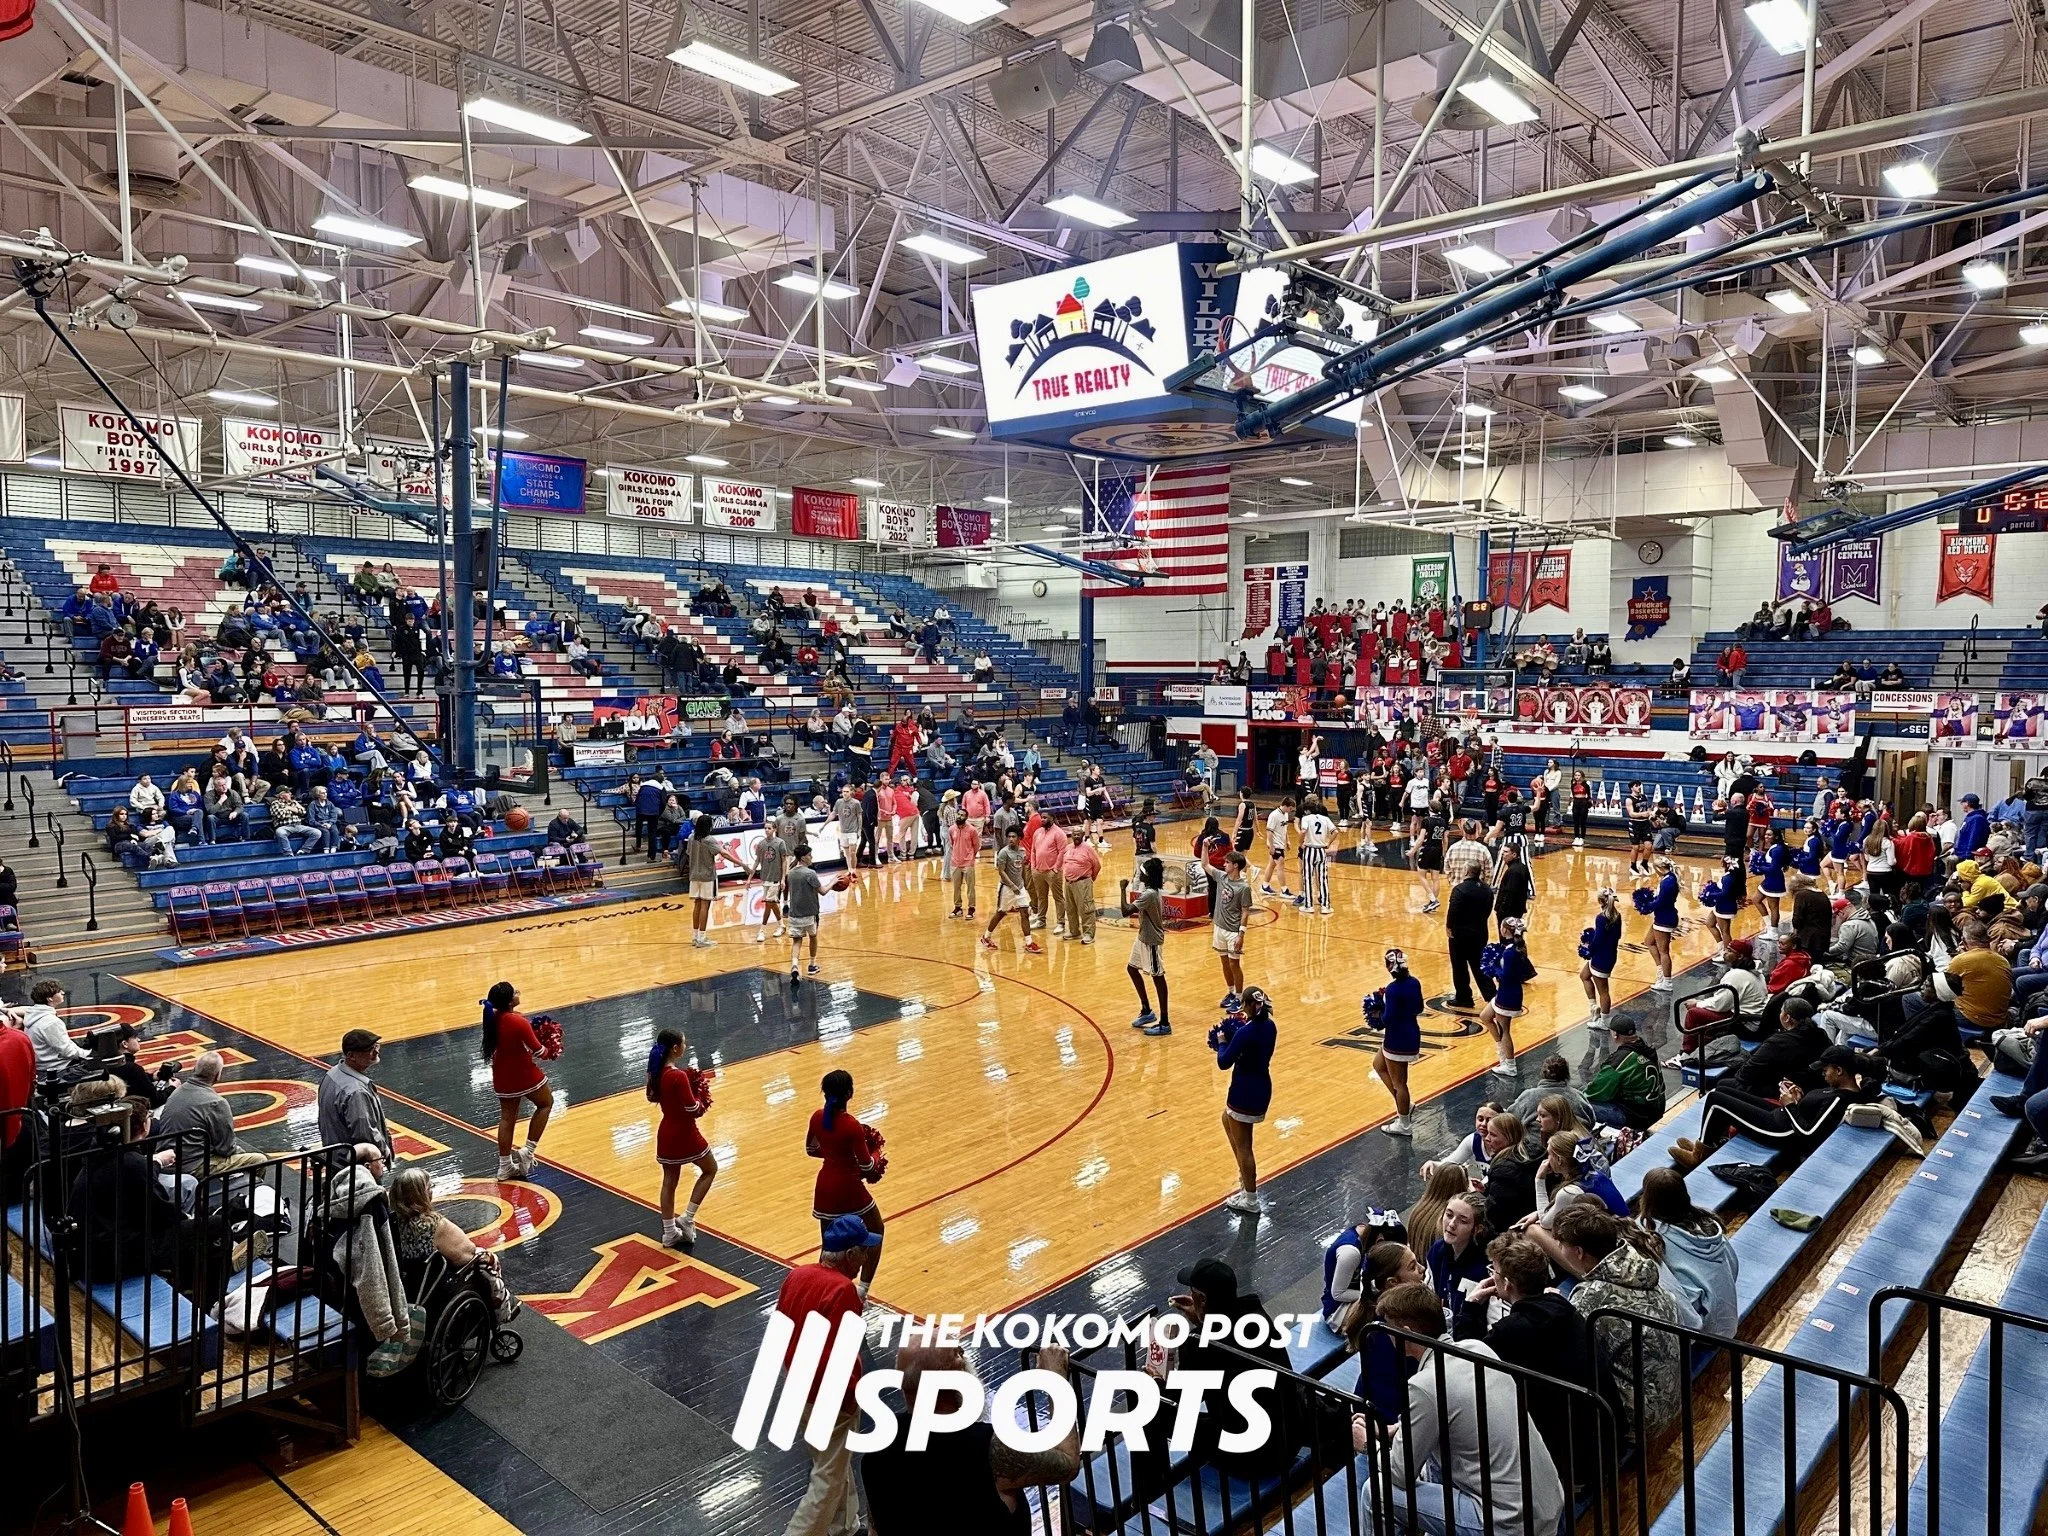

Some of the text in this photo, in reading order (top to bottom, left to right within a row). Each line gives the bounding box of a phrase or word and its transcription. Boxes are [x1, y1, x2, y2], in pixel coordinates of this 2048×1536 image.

[1032, 363, 1131, 402] TRUE REALTY
[88, 413, 175, 437] KOKOMO
[247, 426, 323, 446] KOKOMO
[97, 446, 161, 461] FINAL FOU
[239, 441, 276, 453] GIRLS
[277, 446, 313, 458] CLASS
[108, 458, 158, 476] 1997
[518, 460, 562, 474] KOKOMO
[526, 478, 555, 490] STATE
[623, 470, 677, 487] KOKOMO
[520, 487, 562, 500] CHAMPS
[617, 483, 683, 498] GIRLS CLASS 4A
[717, 482, 764, 499] KOKOMO
[532, 497, 550, 505] 2003
[627, 495, 675, 508] FINAL FOUR
[712, 494, 769, 509] GIRLS CLASS 4A
[803, 493, 849, 508] KOKOMO
[635, 504, 666, 518] 2005
[720, 505, 762, 518] FINAL FOUR
[810, 509, 843, 522] STATE
[879, 504, 917, 519] KOKOMO
[947, 510, 982, 523] KOKOMO
[728, 515, 757, 528] 2006
[886, 514, 910, 527] BOYS
[2010, 521, 2036, 531] period
[881, 524, 901, 535] FINAL
[941, 519, 987, 538] BOYS STATE
[888, 531, 909, 541] 2022
[1950, 536, 1987, 547] RICHMOND
[1841, 542, 1871, 555] MUNCIE
[1946, 544, 1990, 555] RED DEVILS
[1837, 551, 1873, 560] CENTRAL
[1416, 562, 1445, 572] ANDERSON
[1629, 607, 1669, 615] Basketball
[1634, 601, 1664, 609] Wildkat
[1098, 688, 1115, 701] MEN
[1171, 685, 1204, 694] CONCESSIONS
[1251, 691, 1288, 700] WILDKAT
[1873, 692, 1933, 704] CONCESSIONS
[1252, 699, 1275, 711] PEP
[136, 708, 198, 717] VISITORS SECTION
[1252, 709, 1286, 721] BAND
[1908, 725, 1929, 734] SEC
[1509, 812, 1524, 827] 32
[1314, 821, 1322, 835] 2
[1431, 825, 1445, 840] 22
[302, 872, 326, 882] KATS
[334, 869, 355, 879] KATS
[239, 880, 264, 889] KATS
[270, 876, 295, 887] KATS
[172, 887, 198, 897] KATS
[207, 884, 232, 893] KATS
